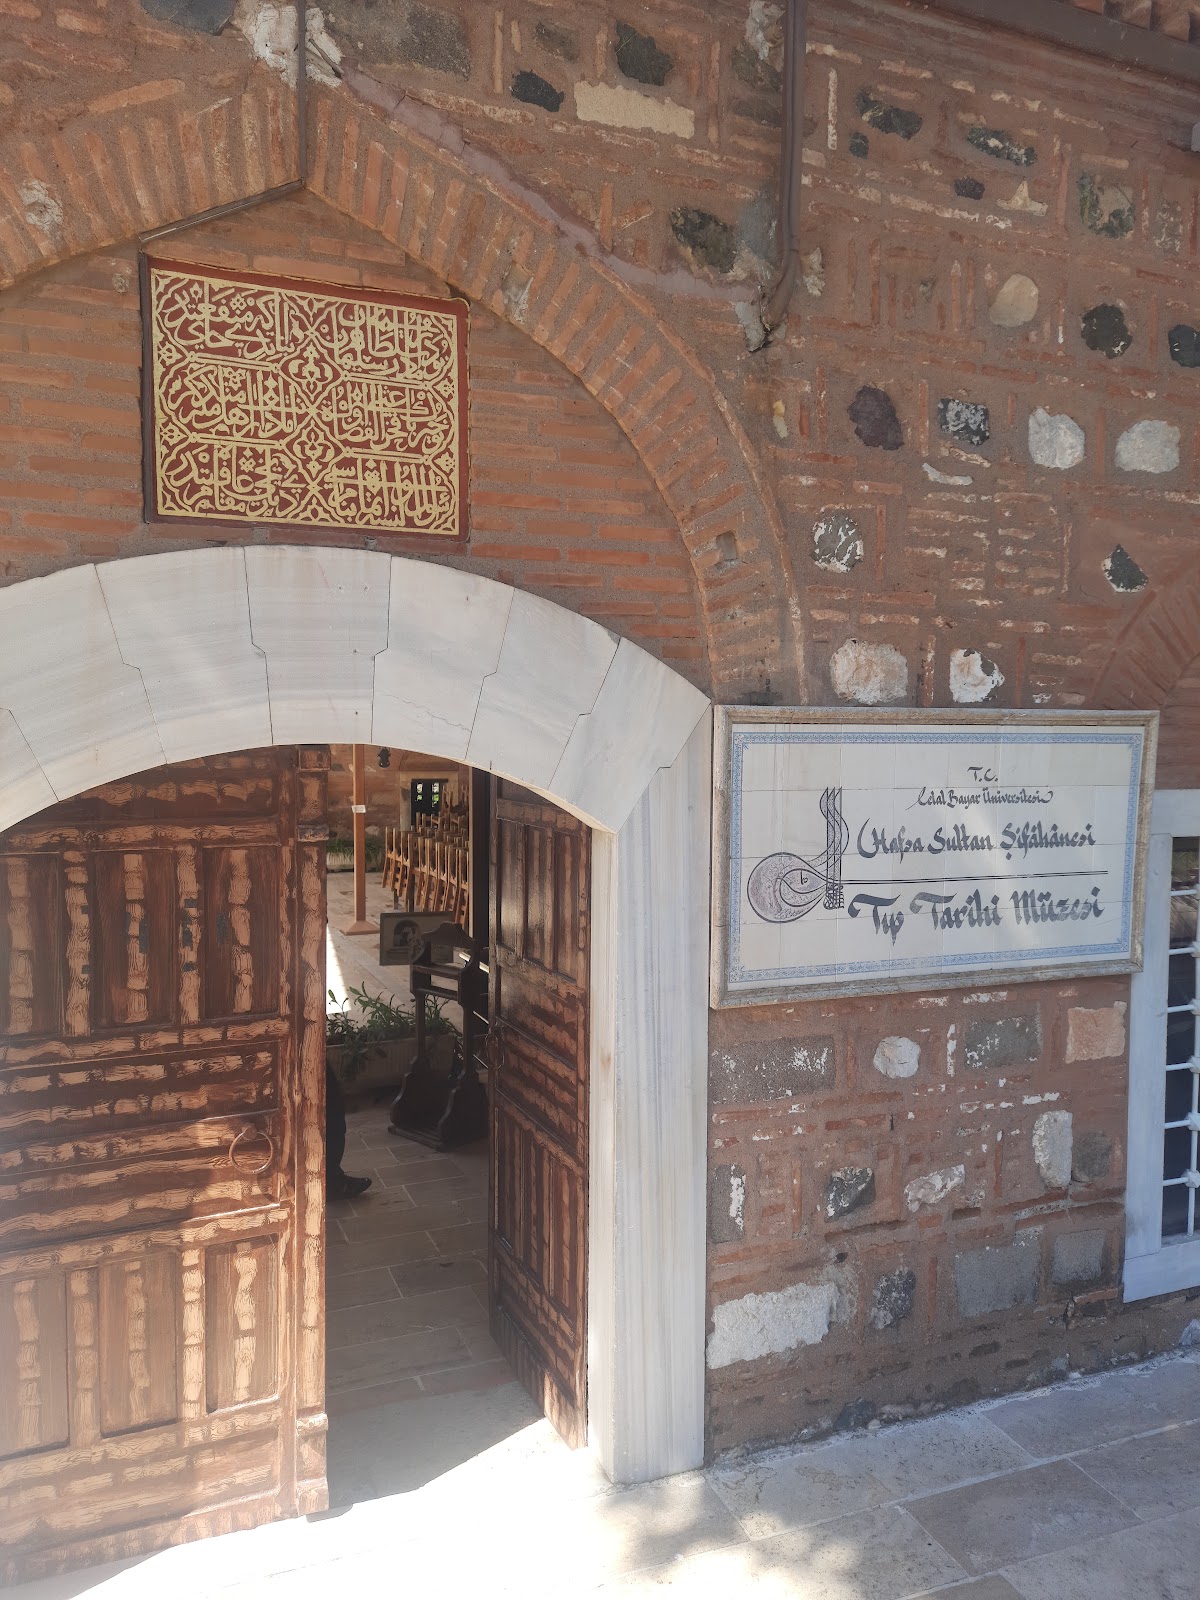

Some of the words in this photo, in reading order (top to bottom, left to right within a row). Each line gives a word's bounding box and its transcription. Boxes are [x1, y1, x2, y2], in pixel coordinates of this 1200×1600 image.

[967, 766, 999, 783] T.C.
[947, 789, 981, 810] Bayar
[983, 787, 1054, 805] Üniversitesi
[857, 817, 925, 864] Hafsa
[928, 823, 993, 854] Sultan
[909, 888, 1003, 931] Tarihi
[1010, 886, 1106, 926] Müzesi
